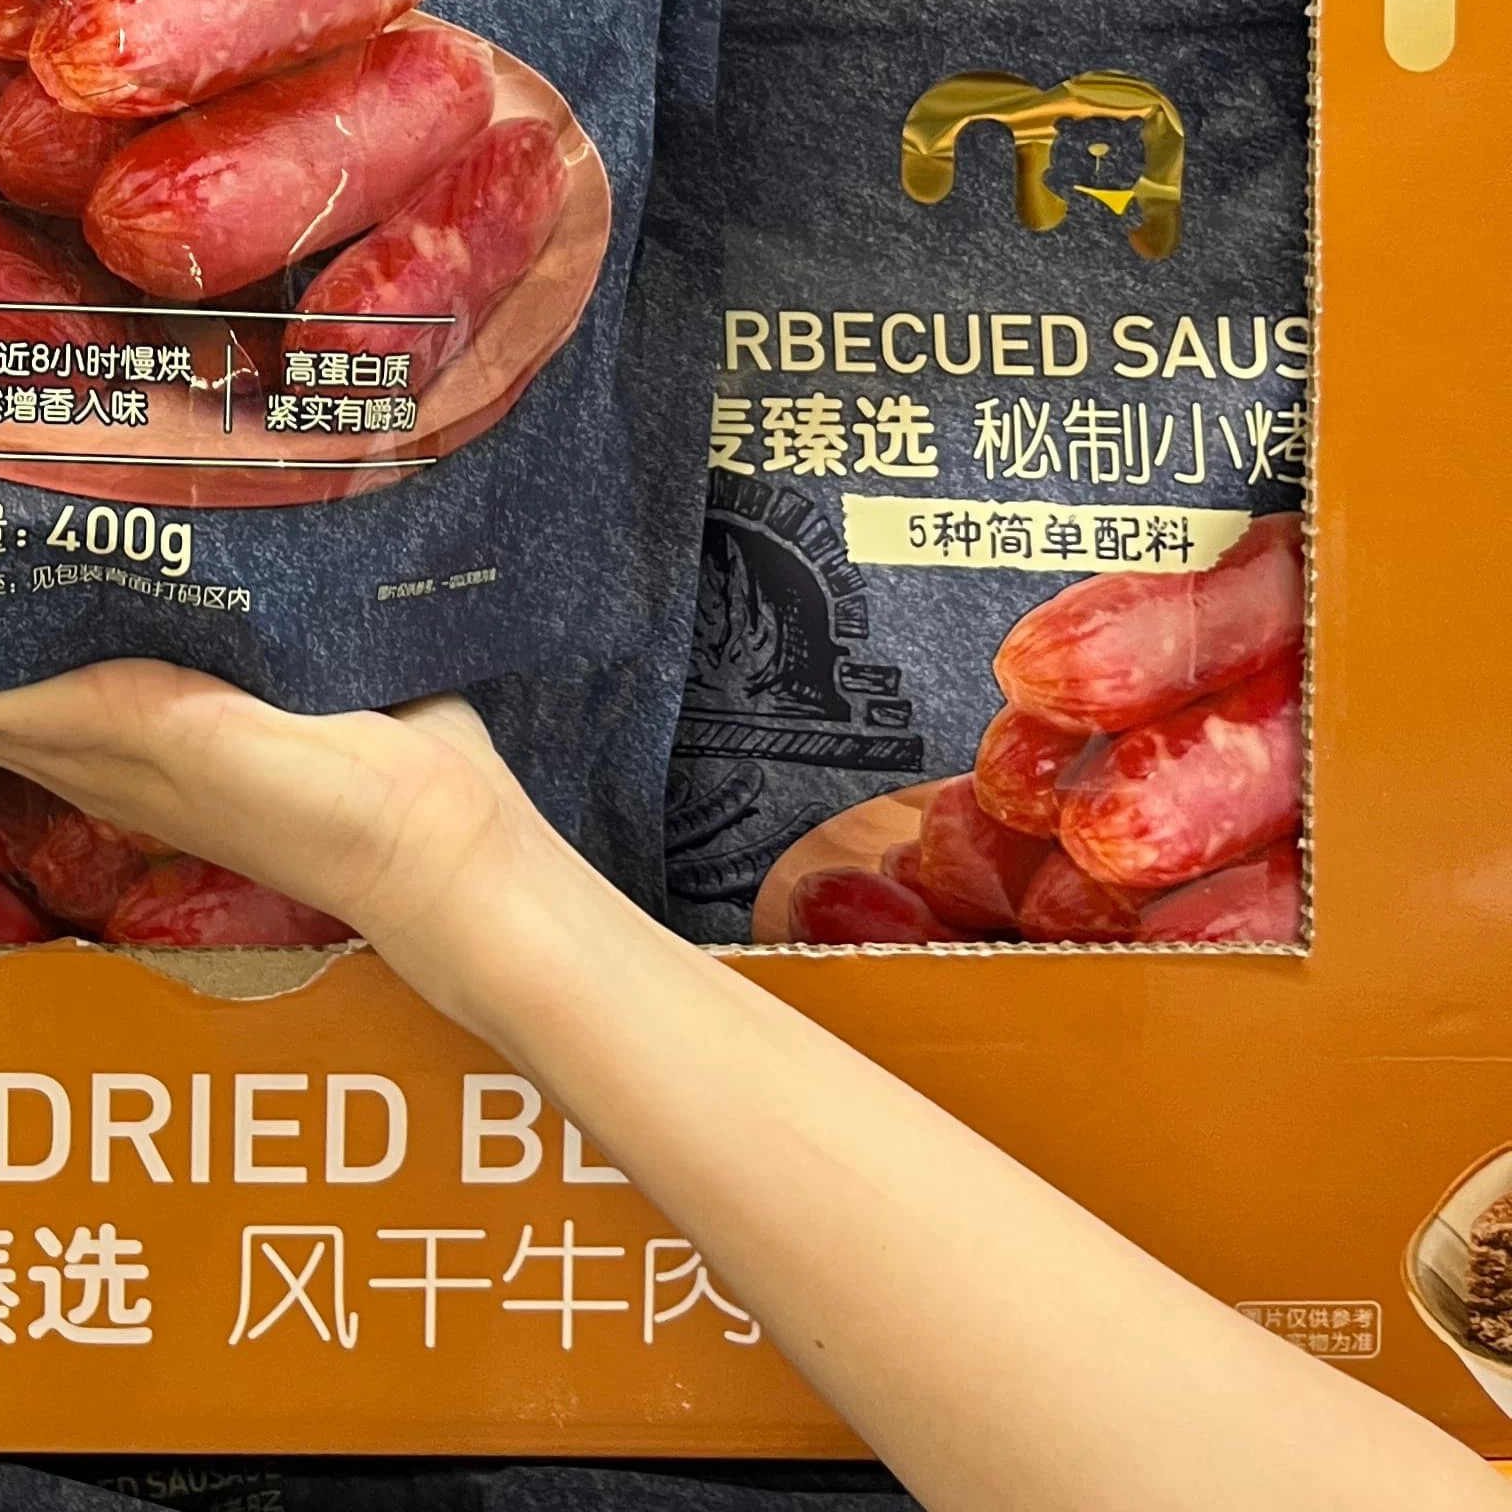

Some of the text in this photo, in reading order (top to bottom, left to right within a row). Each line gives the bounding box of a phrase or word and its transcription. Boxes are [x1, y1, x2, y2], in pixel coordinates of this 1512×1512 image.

[716, 310, 1088, 376] RBECUED
[285, 351, 411, 387] 高蛋白质
[267, 393, 417, 432] 紧实有嚼劲
[908, 511, 1195, 564] 5种简单配料
